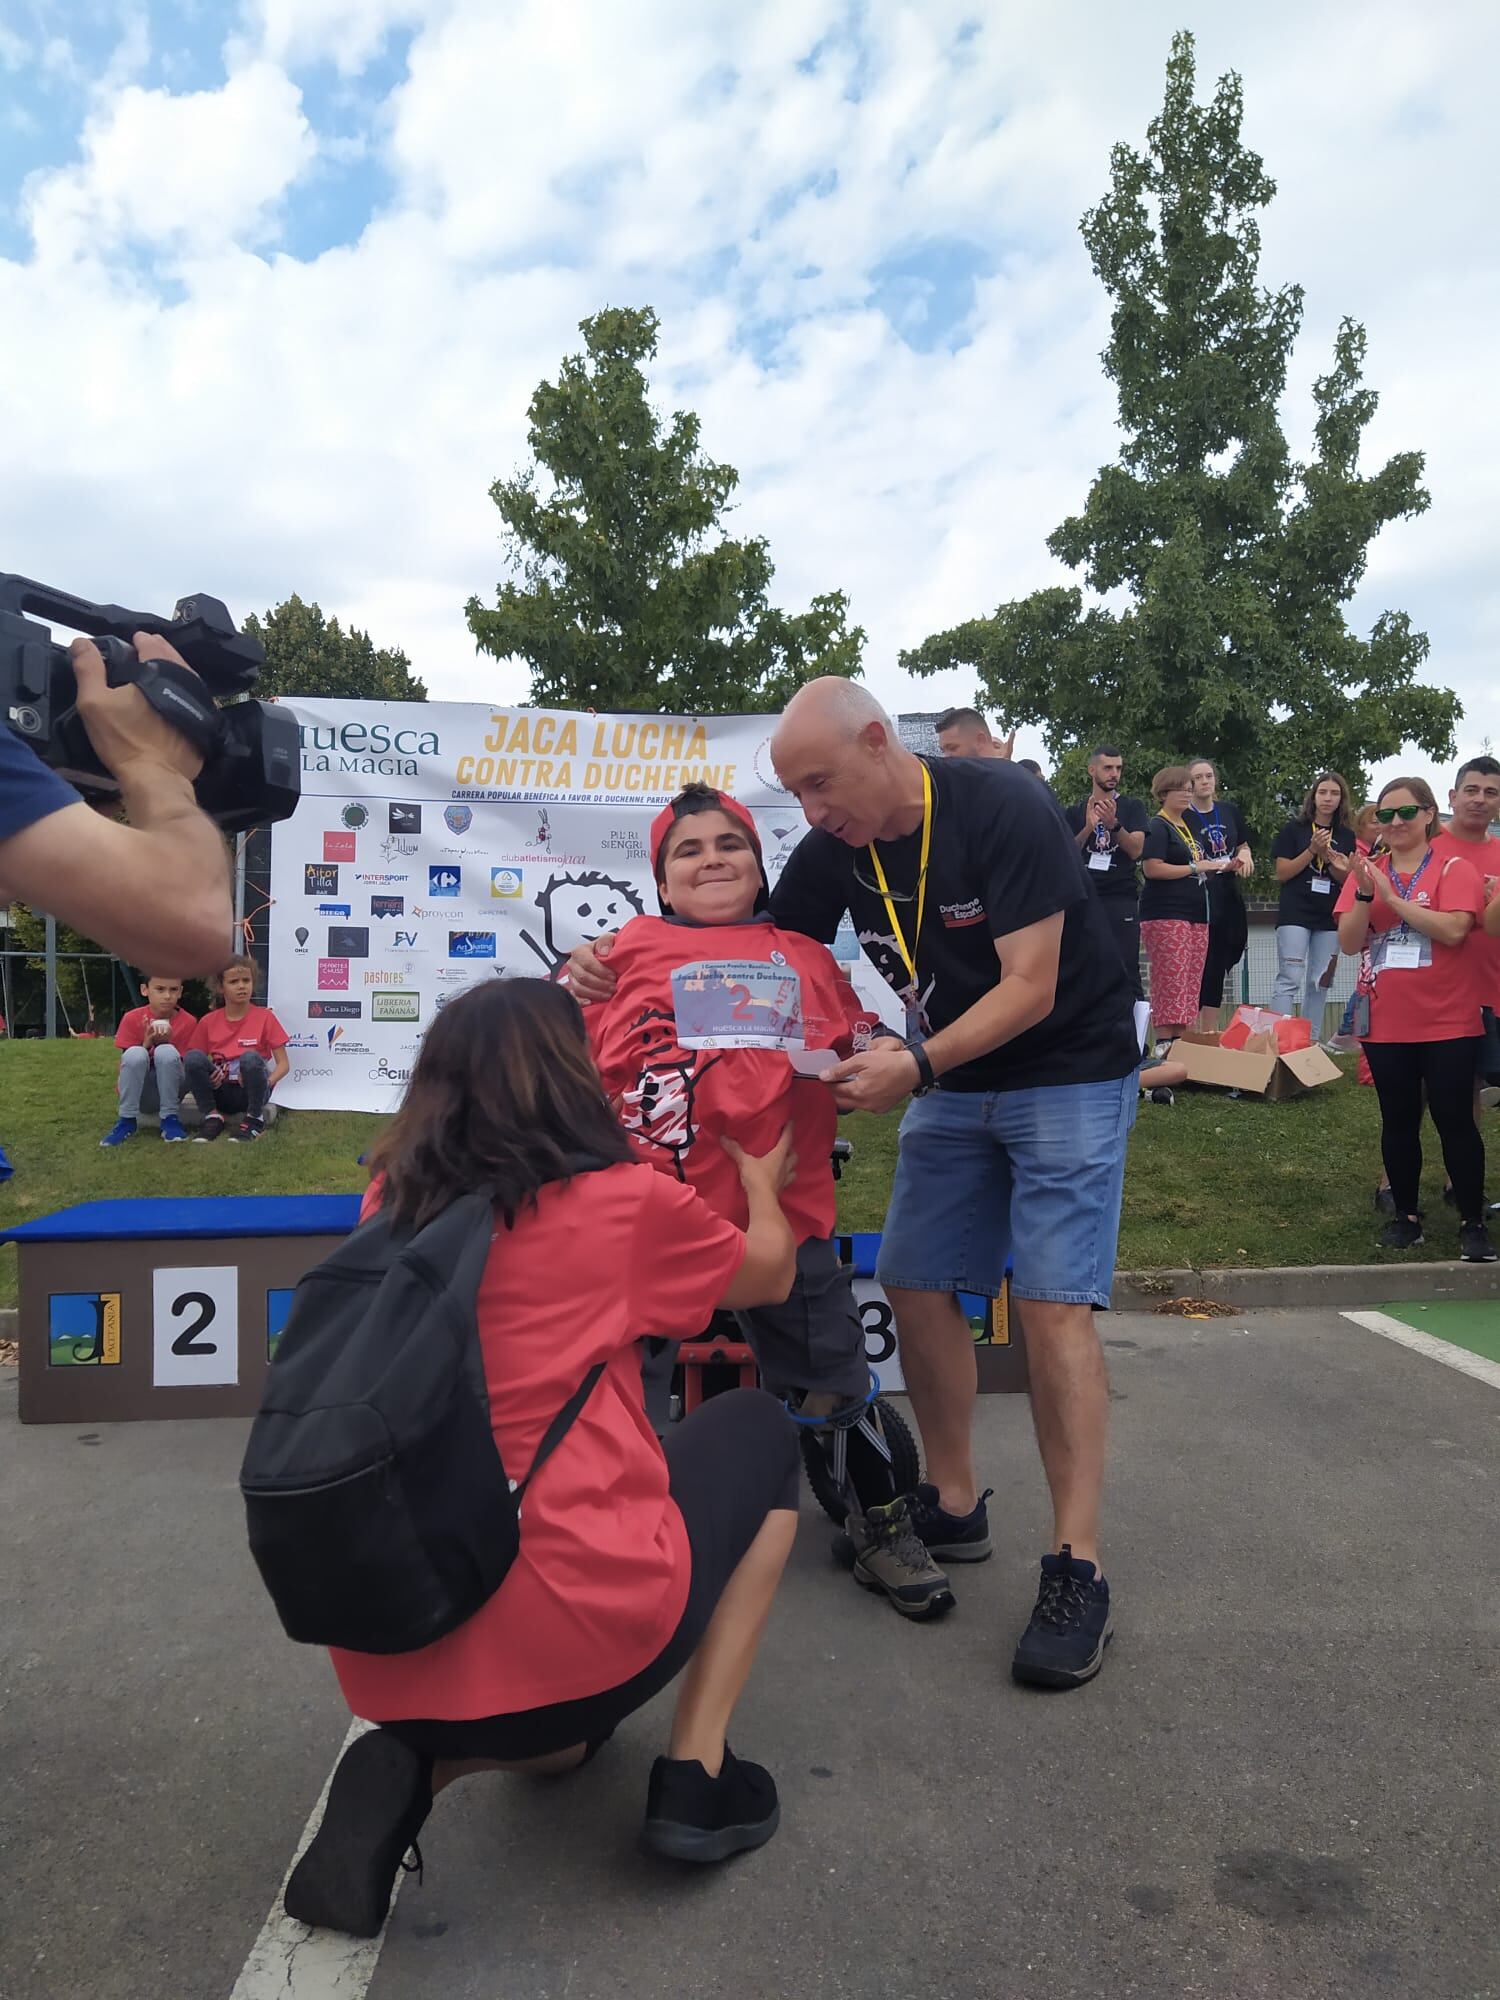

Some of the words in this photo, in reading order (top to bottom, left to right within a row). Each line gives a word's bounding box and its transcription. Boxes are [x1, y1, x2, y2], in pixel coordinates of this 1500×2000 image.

[484, 715, 577, 756] JACA
[592, 721, 707, 761] LUCHA
[303, 754, 330, 772] La
[456, 756, 571, 789] CONTRA
[583, 763, 737, 792] DUCHENNE
[452, 790, 485, 799] CARRERA
[487, 791, 522, 800] POPULAR
[561, 793, 566, 801] A
[568, 794, 591, 802] FAVOR
[605, 795, 645, 804] DUCHENNE
[306, 865, 337, 878] Aitor
[362, 874, 408, 882] INTERSPORT
[309, 877, 333, 888] Tilla
[422, 910, 464, 919] proycon
[364, 970, 404, 984] pastores
[756, 971, 797, 982] Duchenne
[729, 985, 754, 1021] 2
[340, 1006, 360, 1015] Diego
[171, 1291, 218, 1356] 2
[859, 1300, 897, 1363] 3
